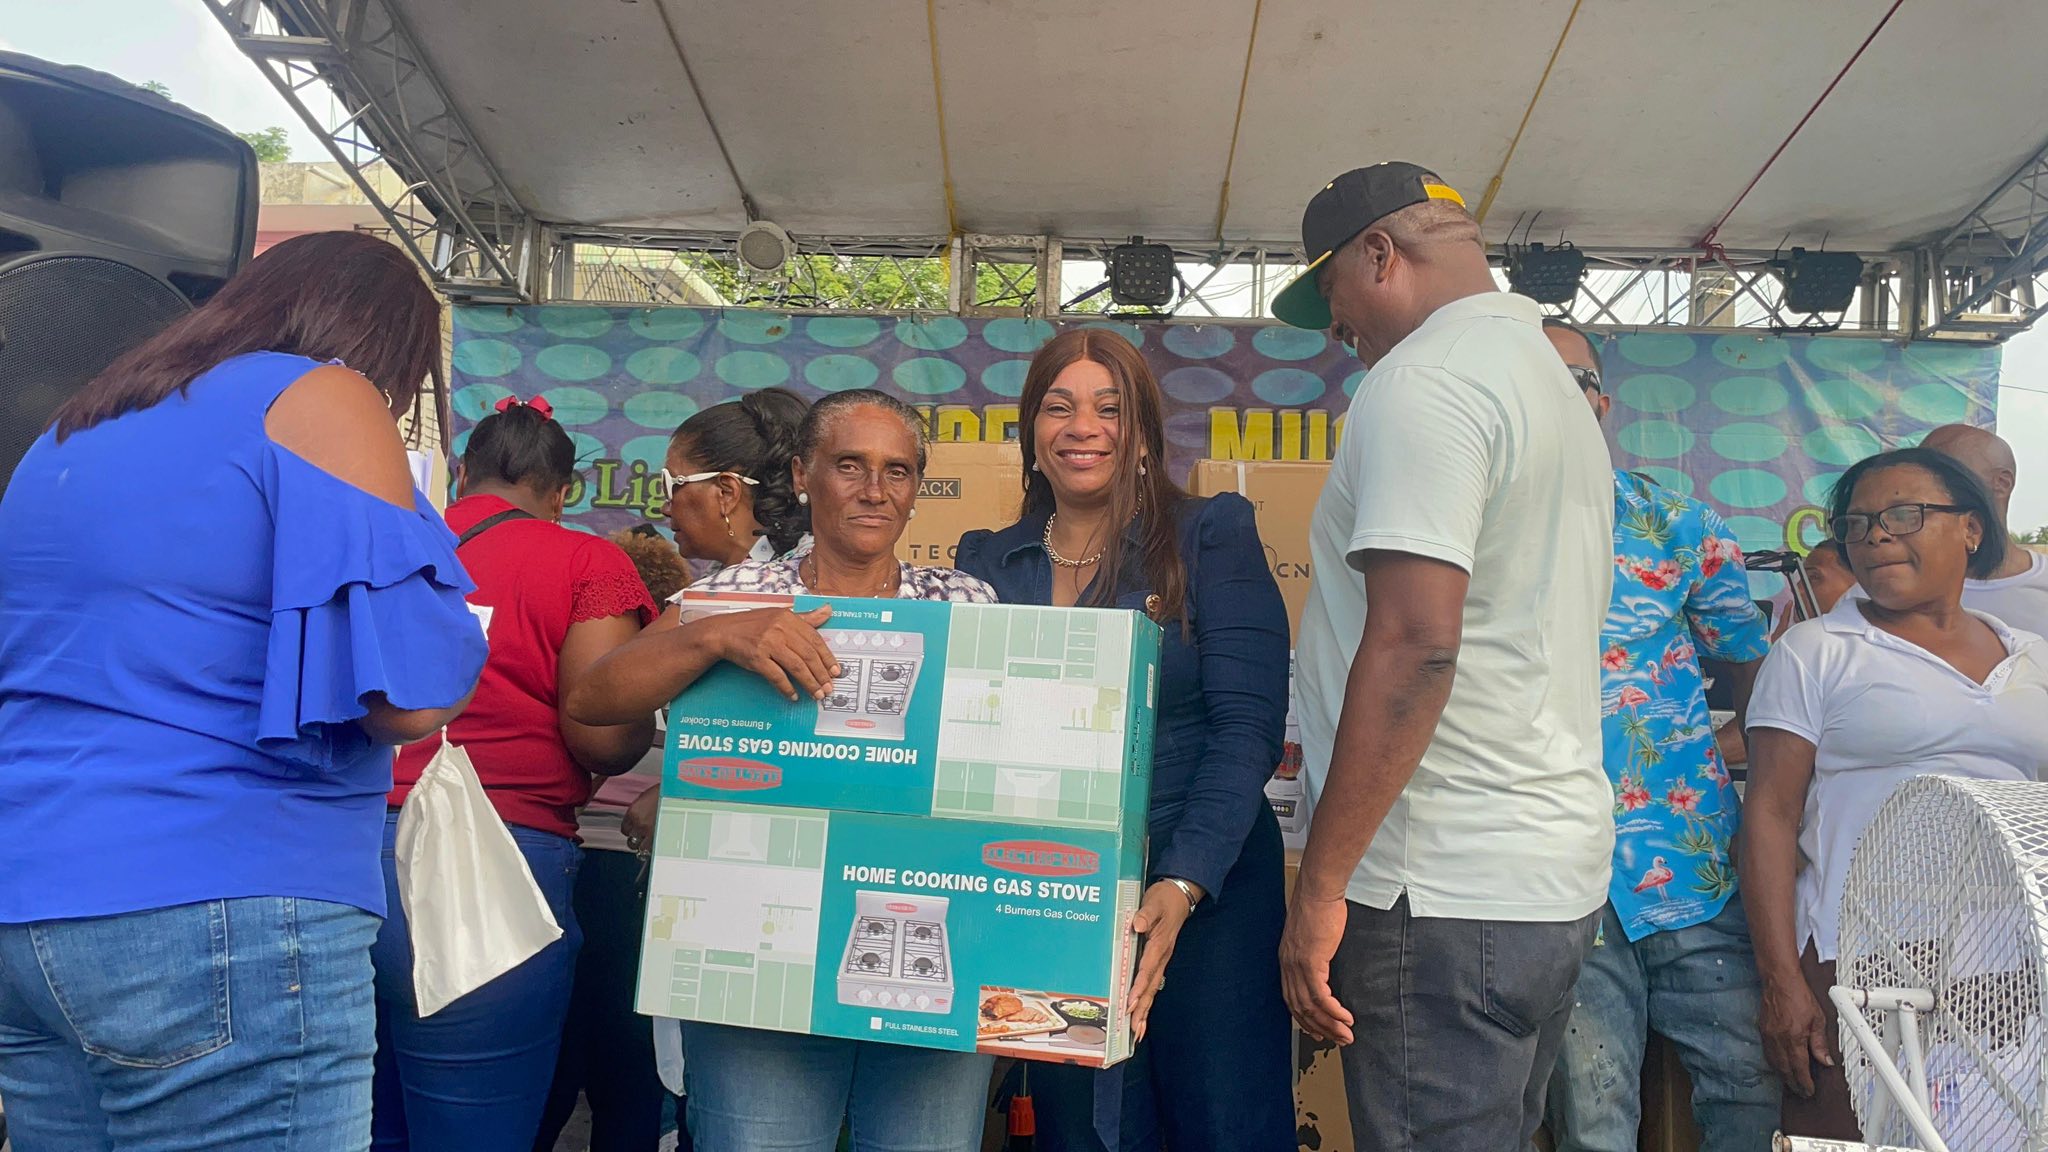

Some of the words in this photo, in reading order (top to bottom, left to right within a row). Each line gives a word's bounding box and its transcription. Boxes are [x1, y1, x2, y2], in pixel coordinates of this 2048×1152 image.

[680, 716, 711, 727] Cooker
[712, 718, 730, 728] Gas
[731, 719, 764, 730] Burners
[765, 721, 772, 730] 4
[678, 733, 734, 752] STOVE
[738, 737, 774, 755] GAS
[778, 740, 860, 761] COOKING
[865, 746, 918, 764] HOME
[843, 865, 897, 885] HOME
[901, 870, 988, 893] COOKING
[993, 878, 1032, 897] GAS
[1037, 882, 1101, 903] STOVE
[995, 904, 1002, 913] 4
[1004, 905, 1041, 917] Burners
[1043, 908, 1063, 919] Gas
[1065, 909, 1100, 922] Cooker
[885, 1022, 900, 1030] FULL
[902, 1024, 937, 1034] STAINLESS
[938, 1027, 959, 1037] STEEL
